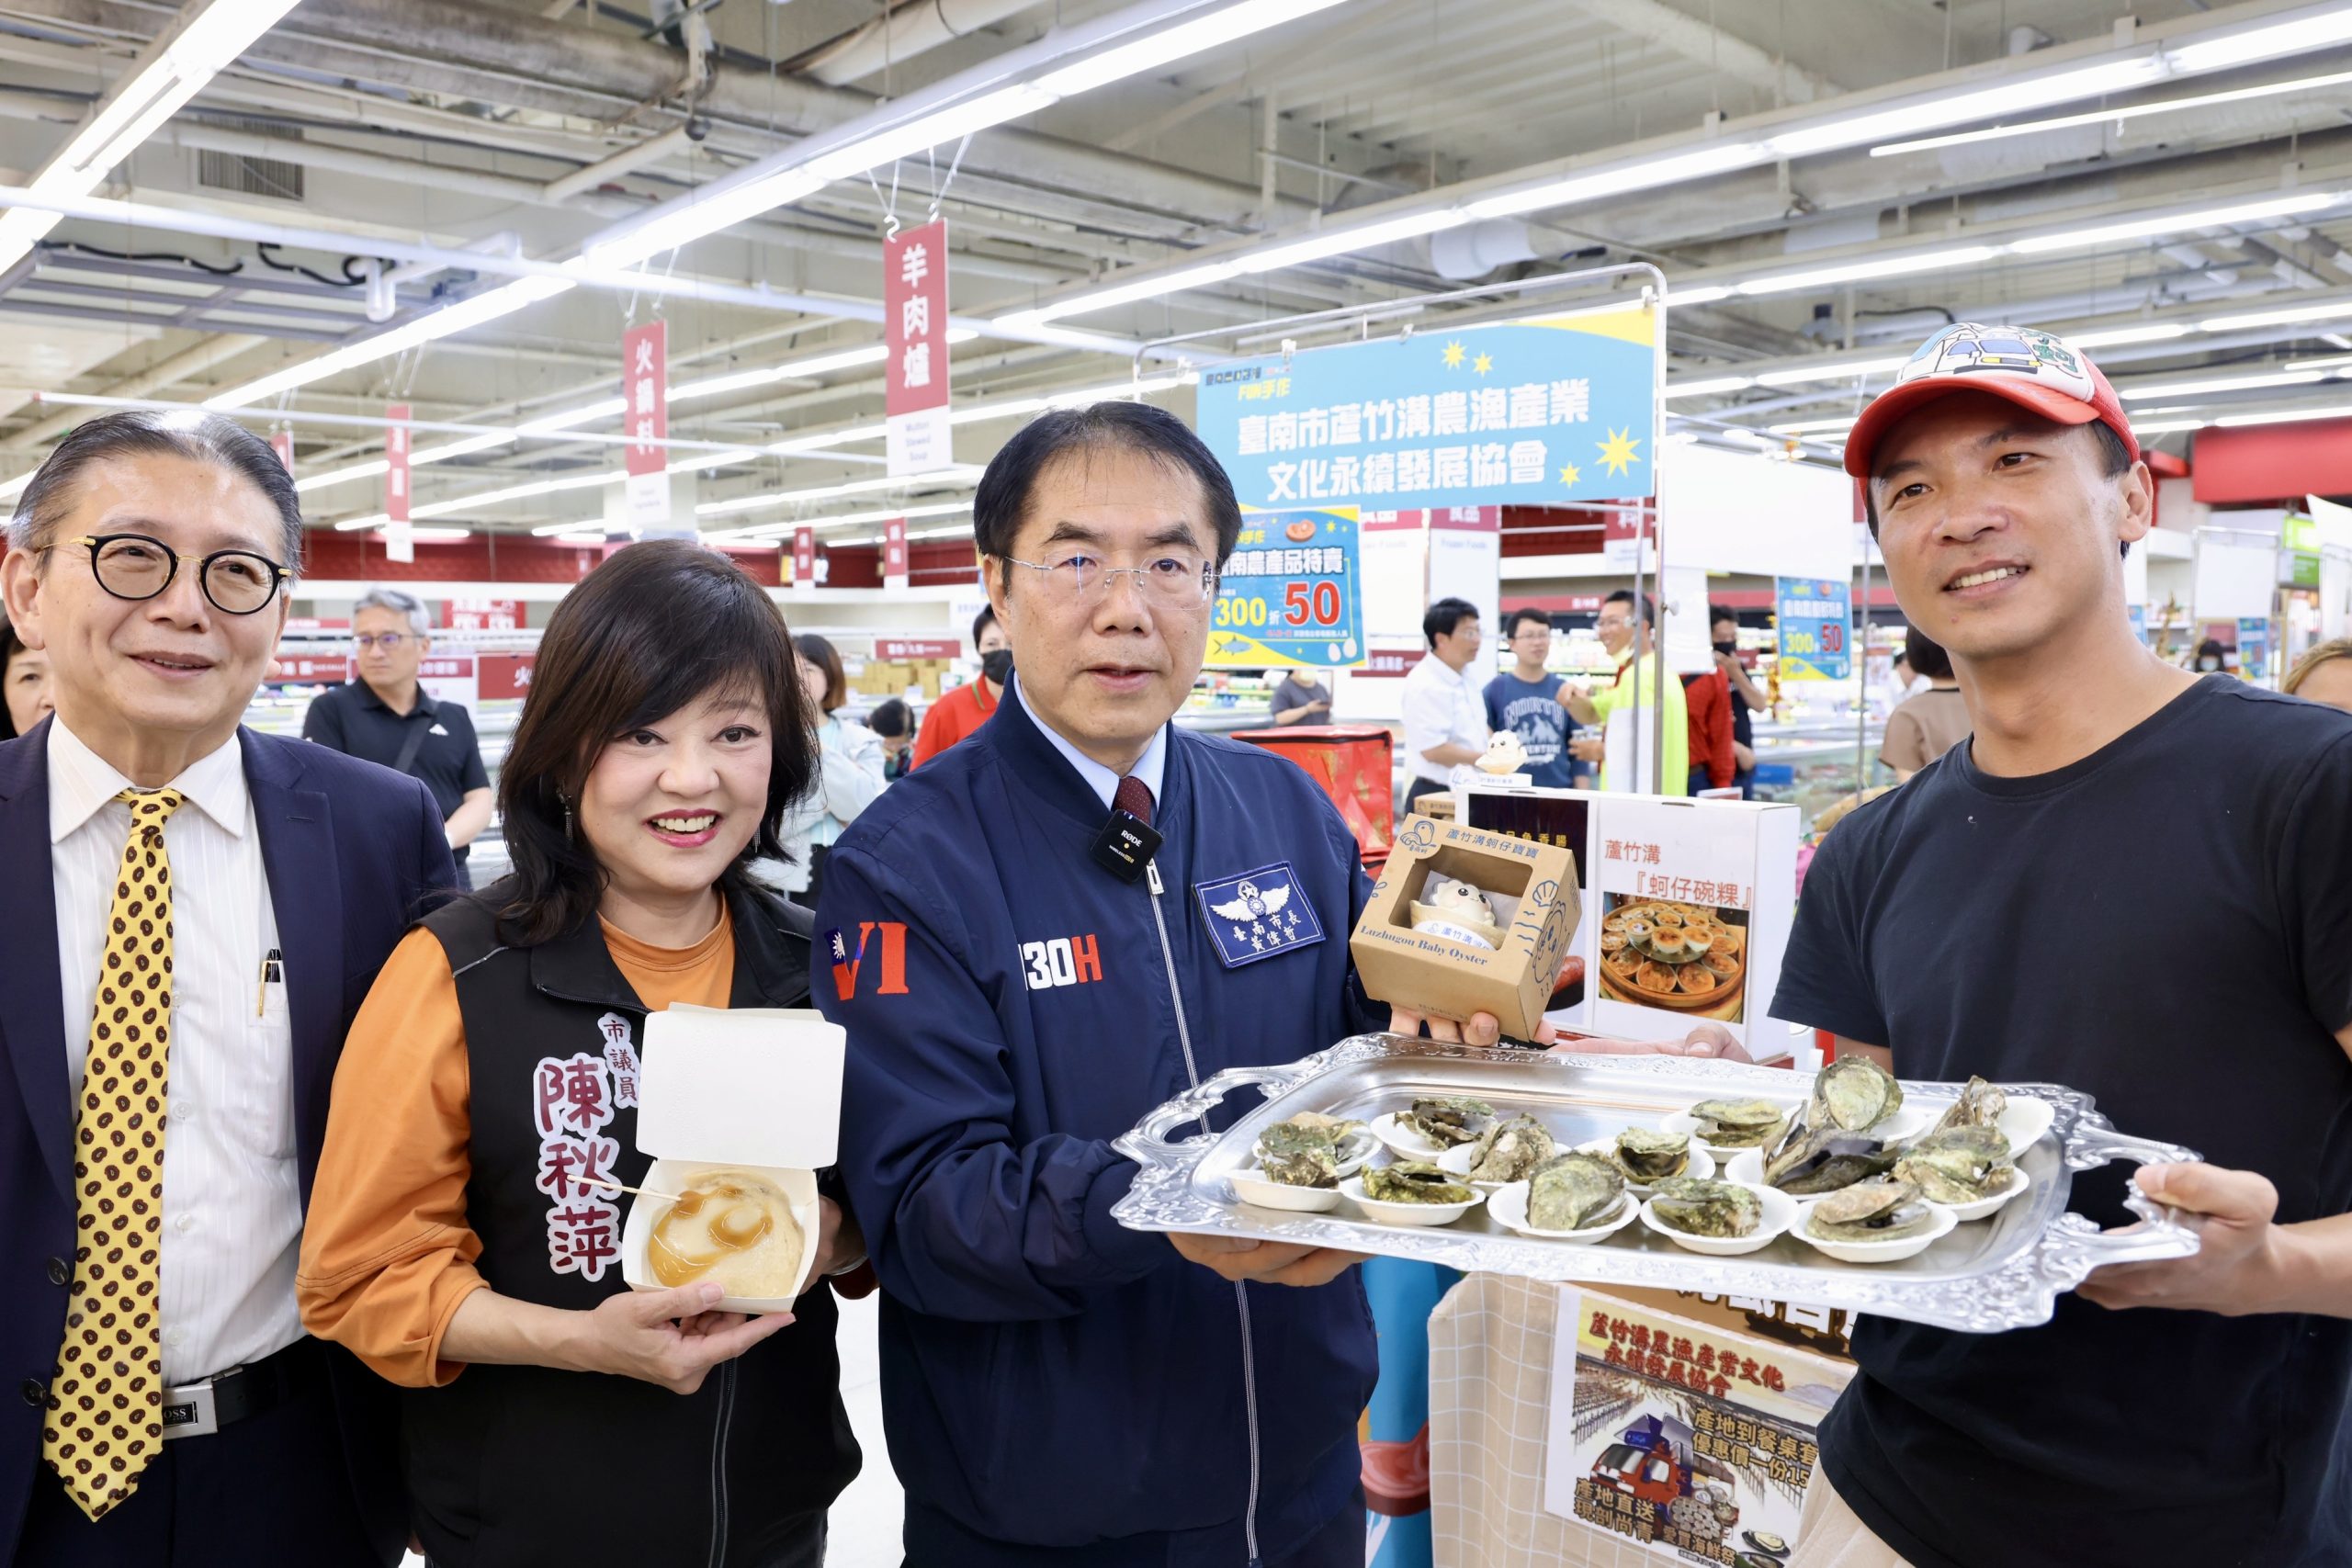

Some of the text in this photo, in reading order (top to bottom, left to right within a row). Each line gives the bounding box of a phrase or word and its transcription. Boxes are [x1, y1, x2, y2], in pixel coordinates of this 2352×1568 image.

[901, 243, 931, 389] 羊肉爐
[635, 338, 656, 455] 火鍋料
[1238, 378, 1590, 455] 臺南市蘆竹溝農漁產業
[1267, 439, 1548, 502] 文化永續發展協會
[1215, 581, 1341, 626] 300 折 50
[1785, 632, 1814, 653] 300
[1822, 624, 1843, 653] 50
[1445, 828, 1541, 859] 蘆竹溝蚵仔寶寶
[1488, 829, 1566, 848] 魚香腸
[1604, 839, 1662, 865] 蘆竹溝
[1233, 909, 1302, 942] 臺南市長
[1251, 927, 1296, 953] 黃偉哲
[1360, 925, 1487, 965] Luzhugou Baby Oyster
[1018, 933, 1103, 991] 30H
[603, 1020, 639, 1101] 市議員
[539, 1058, 616, 1275] 陳秋萍
[1589, 1311, 1785, 1392] 蘆竹溝農漁產業文化
[1604, 1342, 1733, 1399] 永續發展協會
[164, 1408, 187, 1418] OSS
[1573, 1496, 1654, 1544] 現剖尚青
[1574, 1477, 1655, 1523] 產地直送
[1662, 1526, 1736, 1568] 愛買海鮮祭
